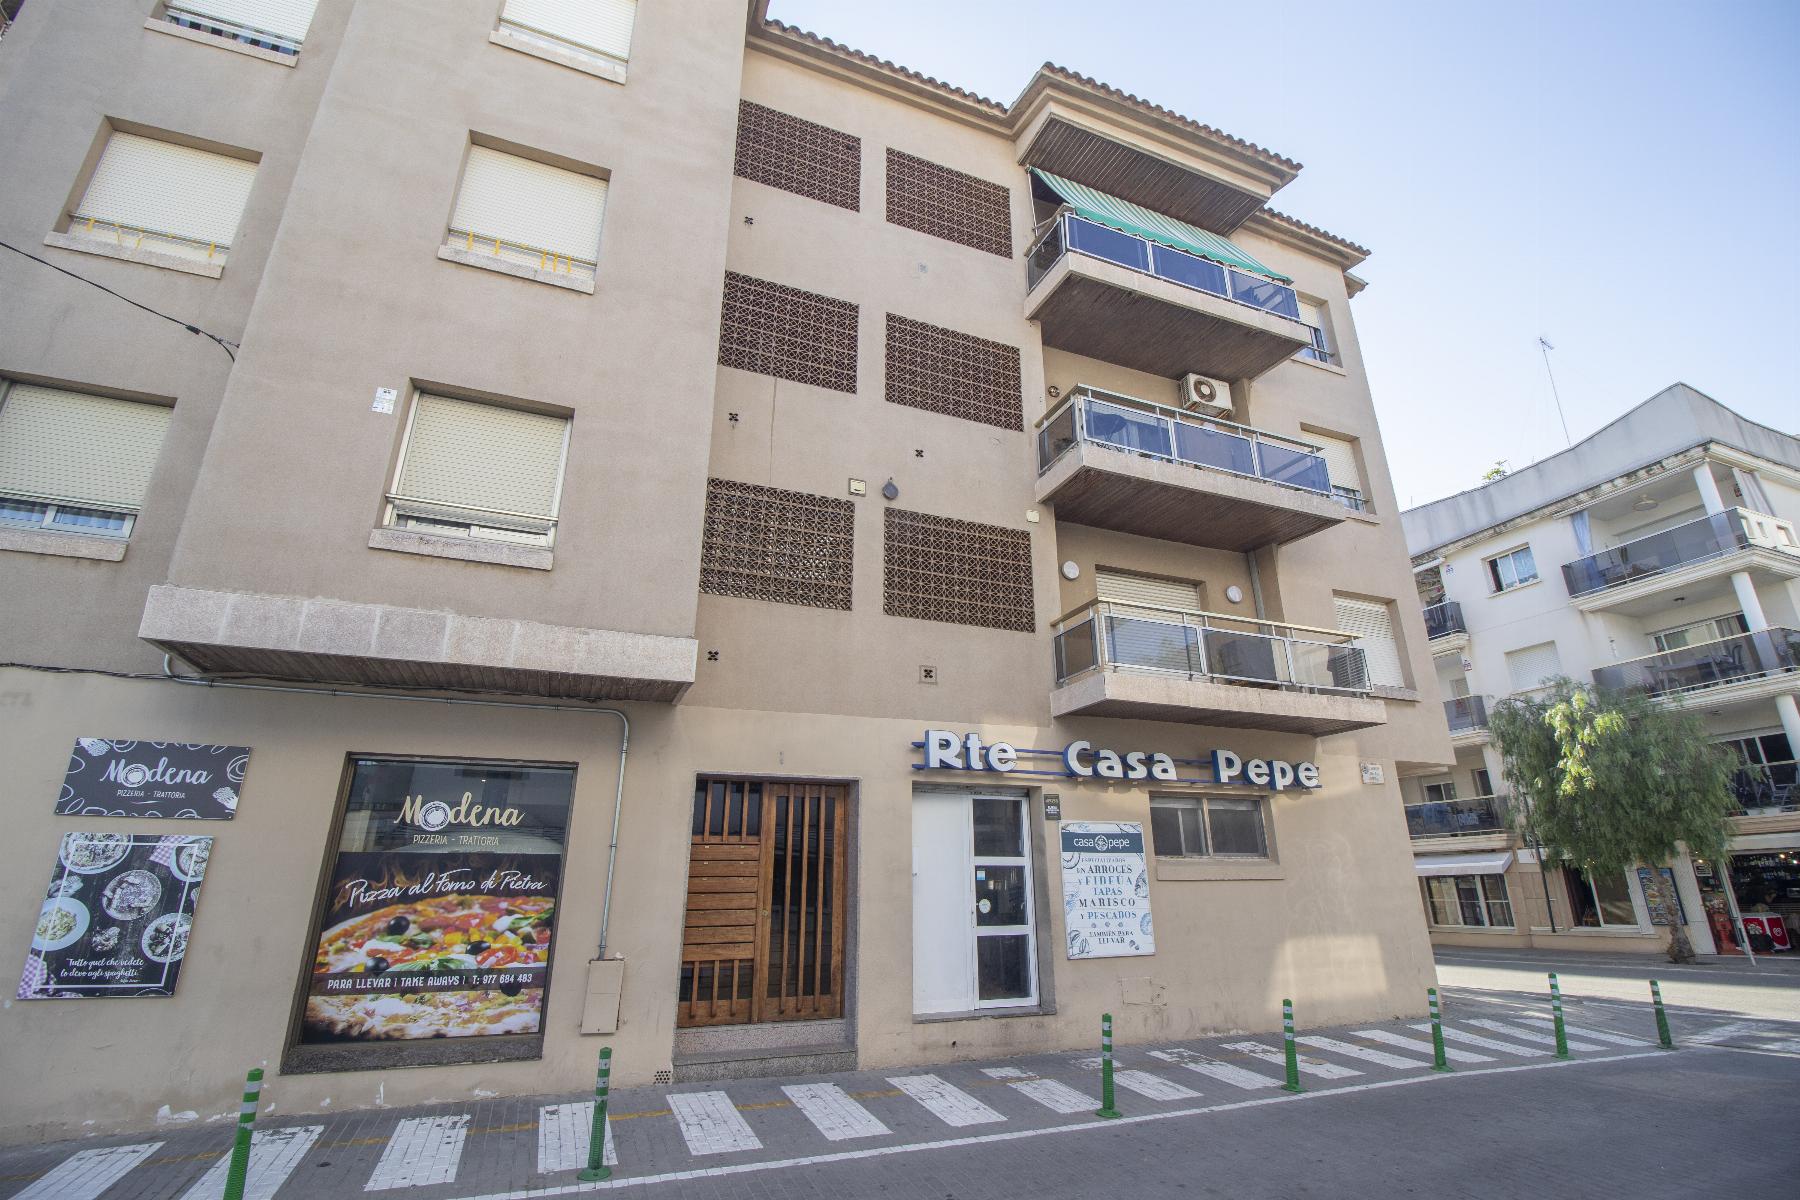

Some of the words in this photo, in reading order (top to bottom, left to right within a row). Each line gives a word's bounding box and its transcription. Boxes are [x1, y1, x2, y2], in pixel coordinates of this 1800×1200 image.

[925, 730, 1018, 772] Rte
[1064, 740, 1177, 780] Casa
[1211, 749, 1319, 790] Pepe
[100, 757, 213, 787] Modena
[116, 789, 144, 797] PIZZERIA
[153, 790, 185, 799] TRATTORIA
[394, 791, 526, 831] Modena
[413, 834, 447, 845] PIZZERIA
[459, 835, 499, 846] TRATTORIA
[1073, 838, 1094, 847] casa
[1108, 838, 1130, 849] pepe
[1087, 864, 1133, 874] ARROCES
[345, 879, 407, 907] Pizza
[408, 872, 435, 895] al
[481, 870, 498, 893] di
[500, 870, 549, 891] Pietra
[1094, 887, 1123, 896] TAPAS
[1079, 897, 1135, 908] MARISCO
[1087, 911, 1137, 920] PESCADOS
[1098, 937, 1126, 945] LLEVAR
[89, 958, 105, 969] quel
[106, 958, 120, 967] che
[120, 957, 144, 967] vedete
[69, 968, 87, 977] devo
[328, 979, 352, 989] PARA
[356, 977, 391, 989] LLEVAR
[401, 976, 425, 987] TAKE
[427, 974, 460, 987] AWAYS
[472, 974, 480, 985] T:
[482, 974, 498, 984] 977
[499, 973, 515, 984] 684
[517, 973, 533, 983] 483
